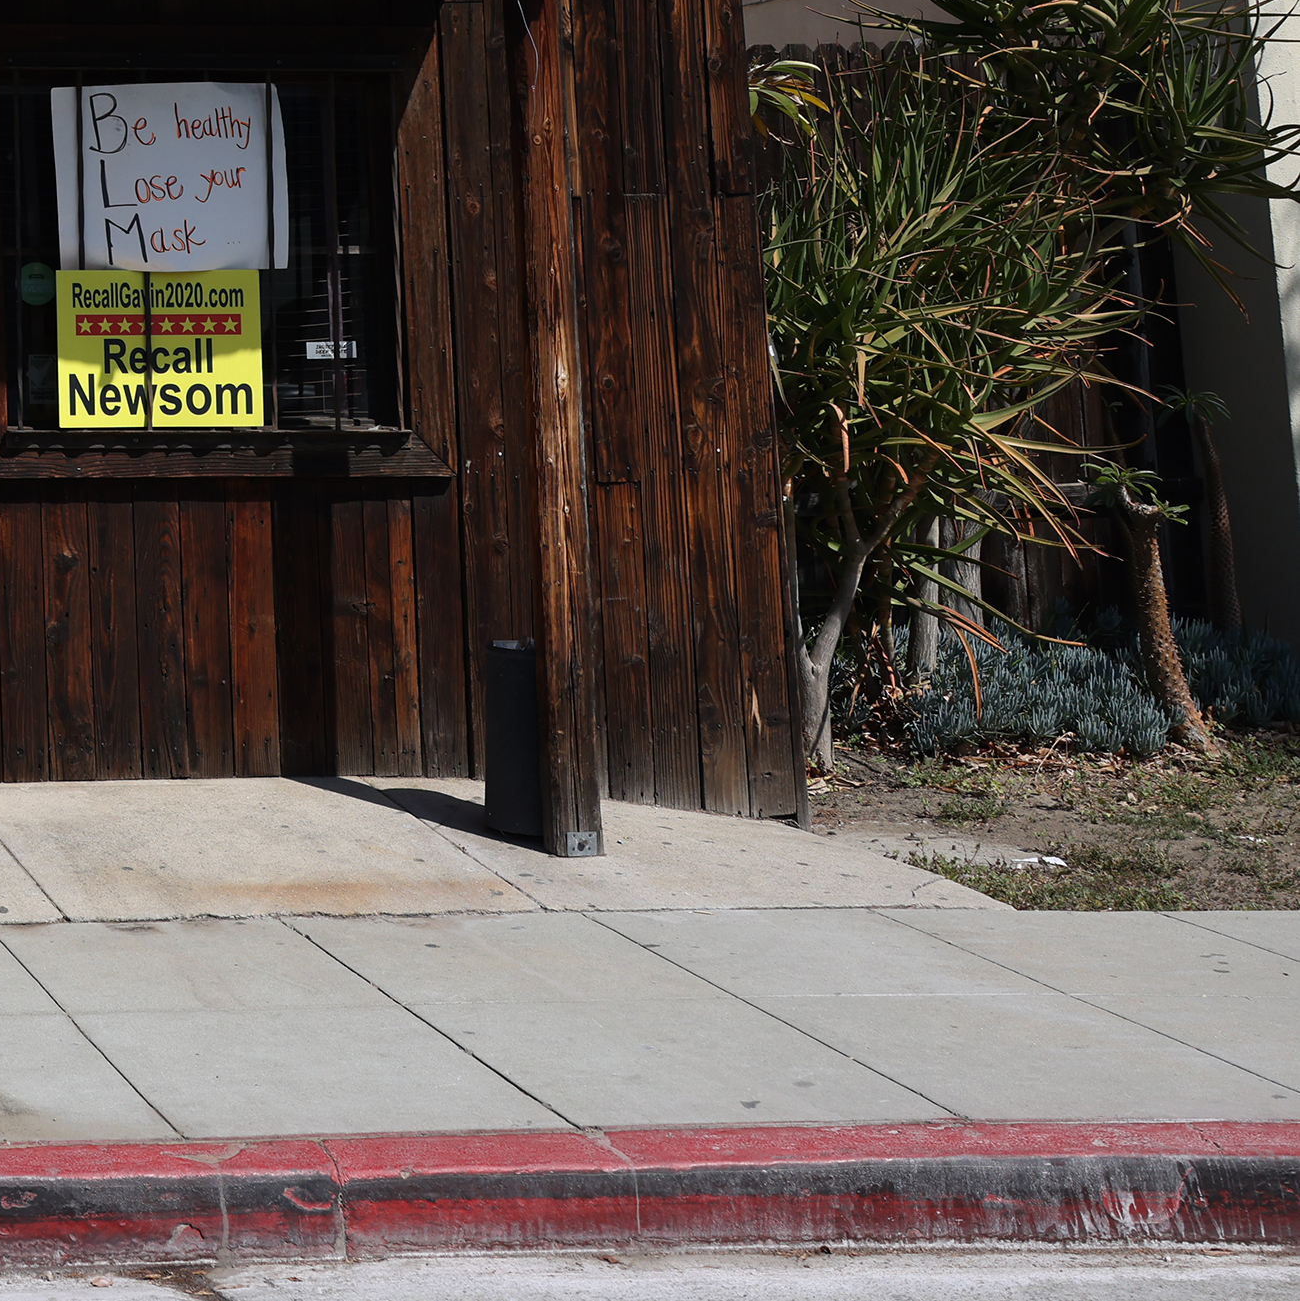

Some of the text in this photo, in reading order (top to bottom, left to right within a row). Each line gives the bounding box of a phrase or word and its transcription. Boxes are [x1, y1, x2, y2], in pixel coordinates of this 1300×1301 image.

[88, 92, 252, 154] Be healthy
[100, 159, 247, 209] Lose your
[104, 212, 207, 266] Mask
[102, 337, 215, 375] Recall
[68, 373, 254, 417] Newsom
